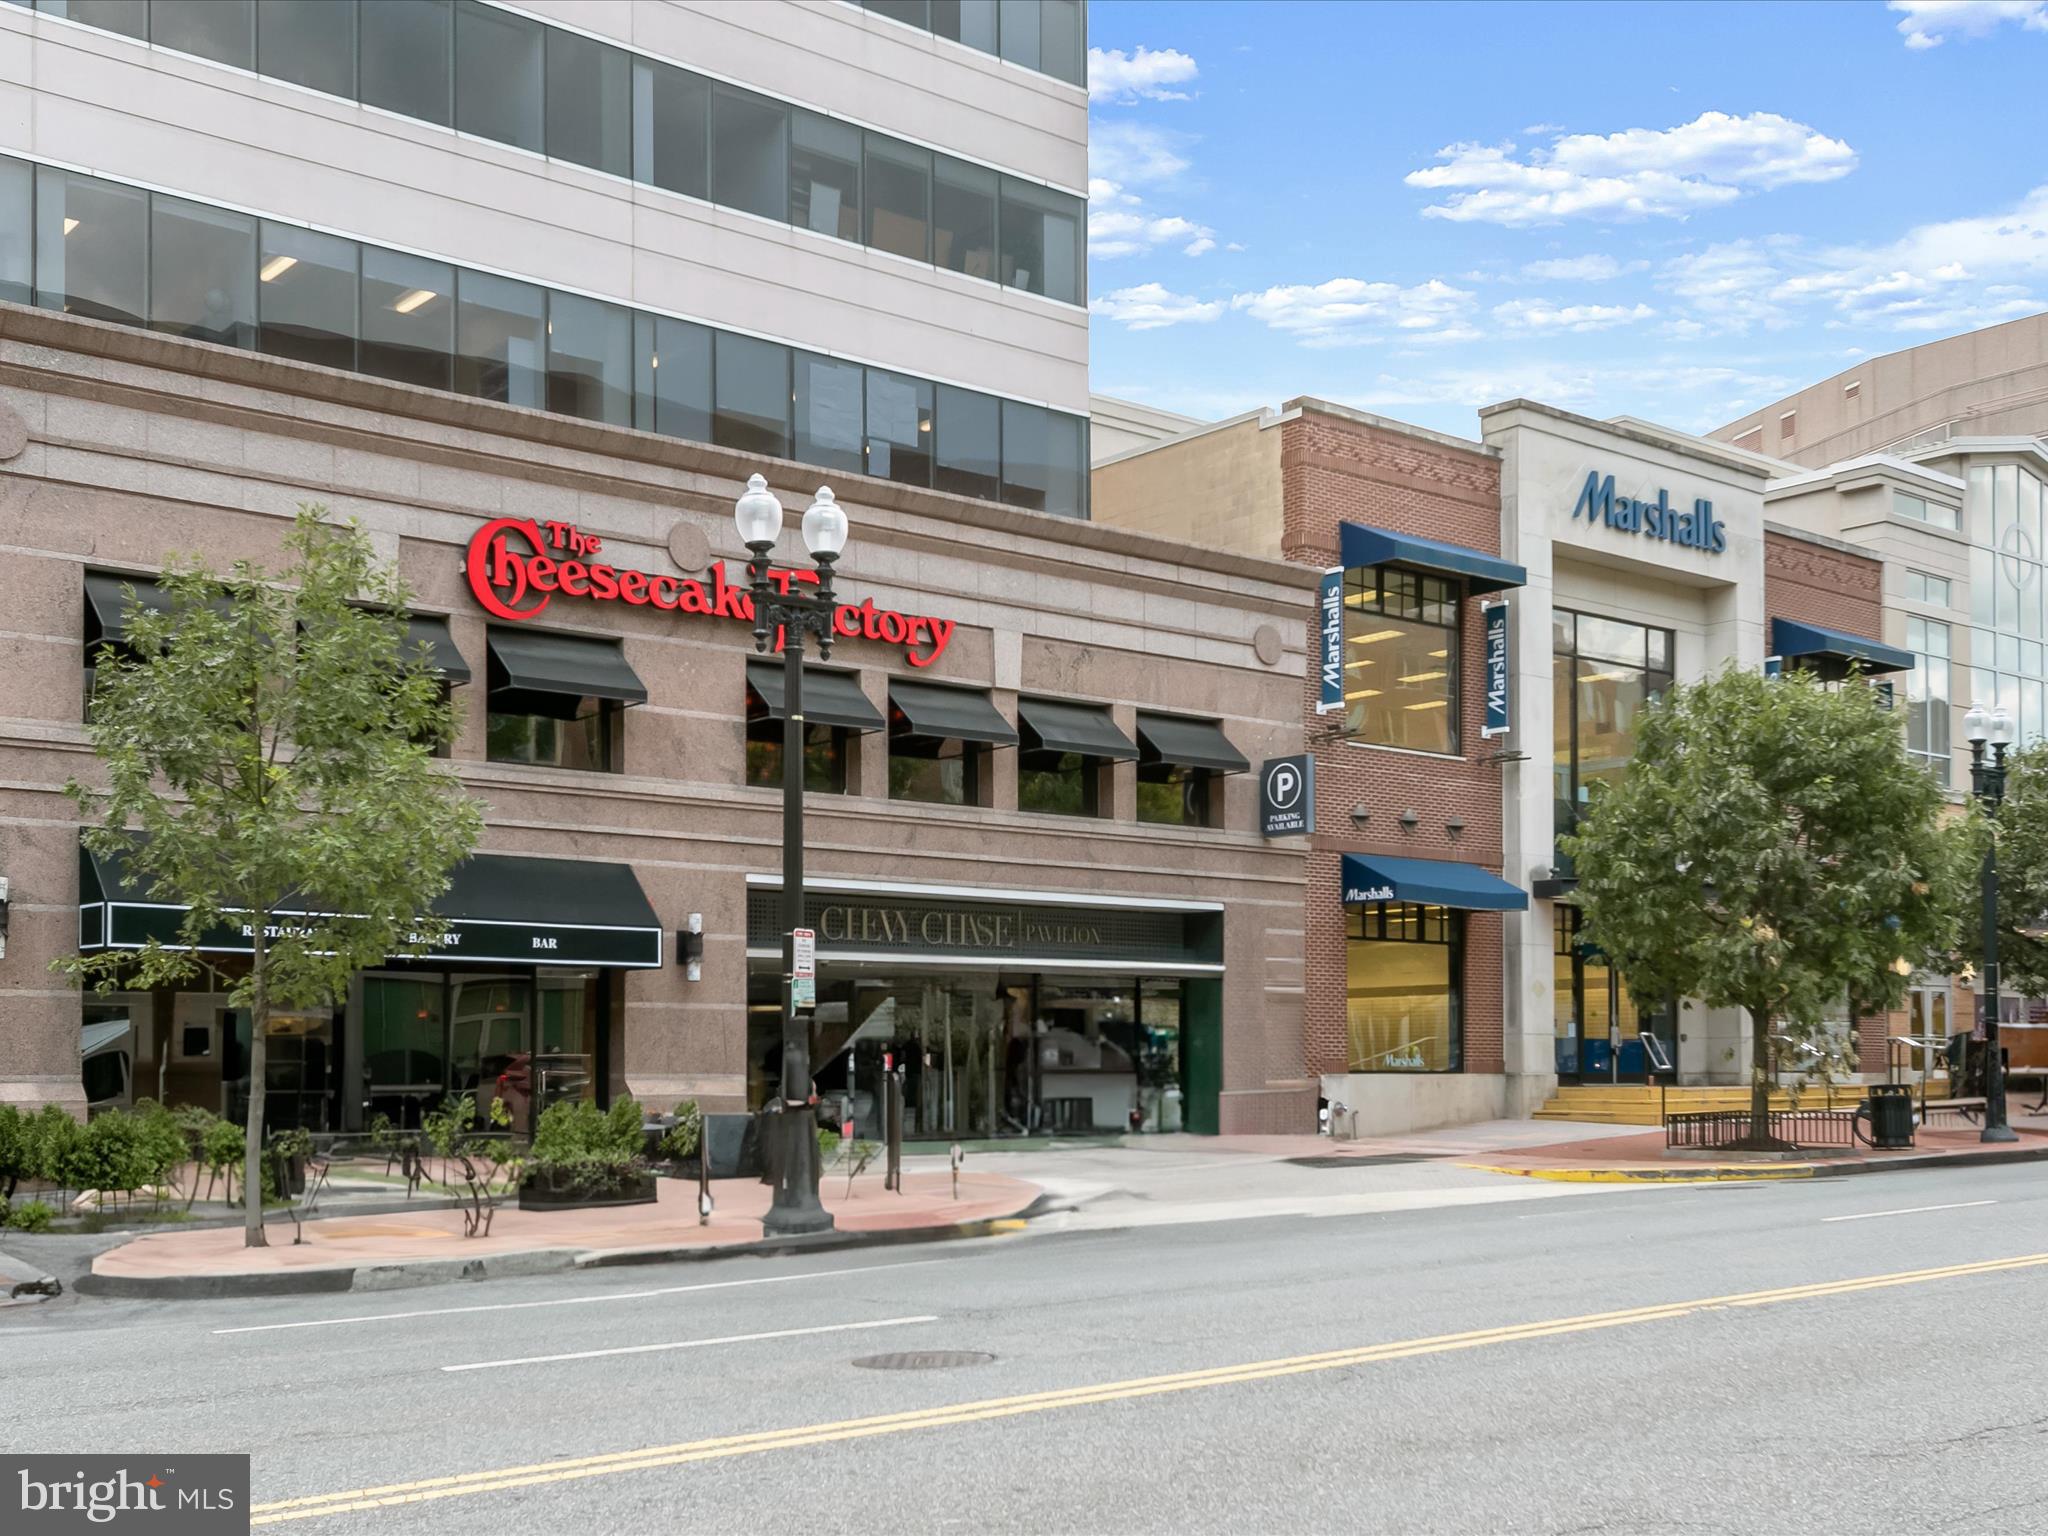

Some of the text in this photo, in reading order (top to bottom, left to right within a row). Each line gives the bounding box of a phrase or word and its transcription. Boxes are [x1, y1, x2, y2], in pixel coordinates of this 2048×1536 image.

[1572, 470, 1726, 553] Marshalls
[546, 520, 602, 557] The
[750, 563, 957, 668] Fctory
[1323, 586, 1340, 689] Marshalls
[1488, 619, 1505, 714] Marshalls
[1277, 772, 1294, 802] P
[1267, 820, 1305, 832] AVAILABLE
[1269, 812, 1301, 823] PARKING
[1345, 886, 1394, 902] Marshalls
[532, 937, 558, 949] BAR
[820, 906, 917, 943] CHEVY
[921, 911, 1014, 947] CHASE
